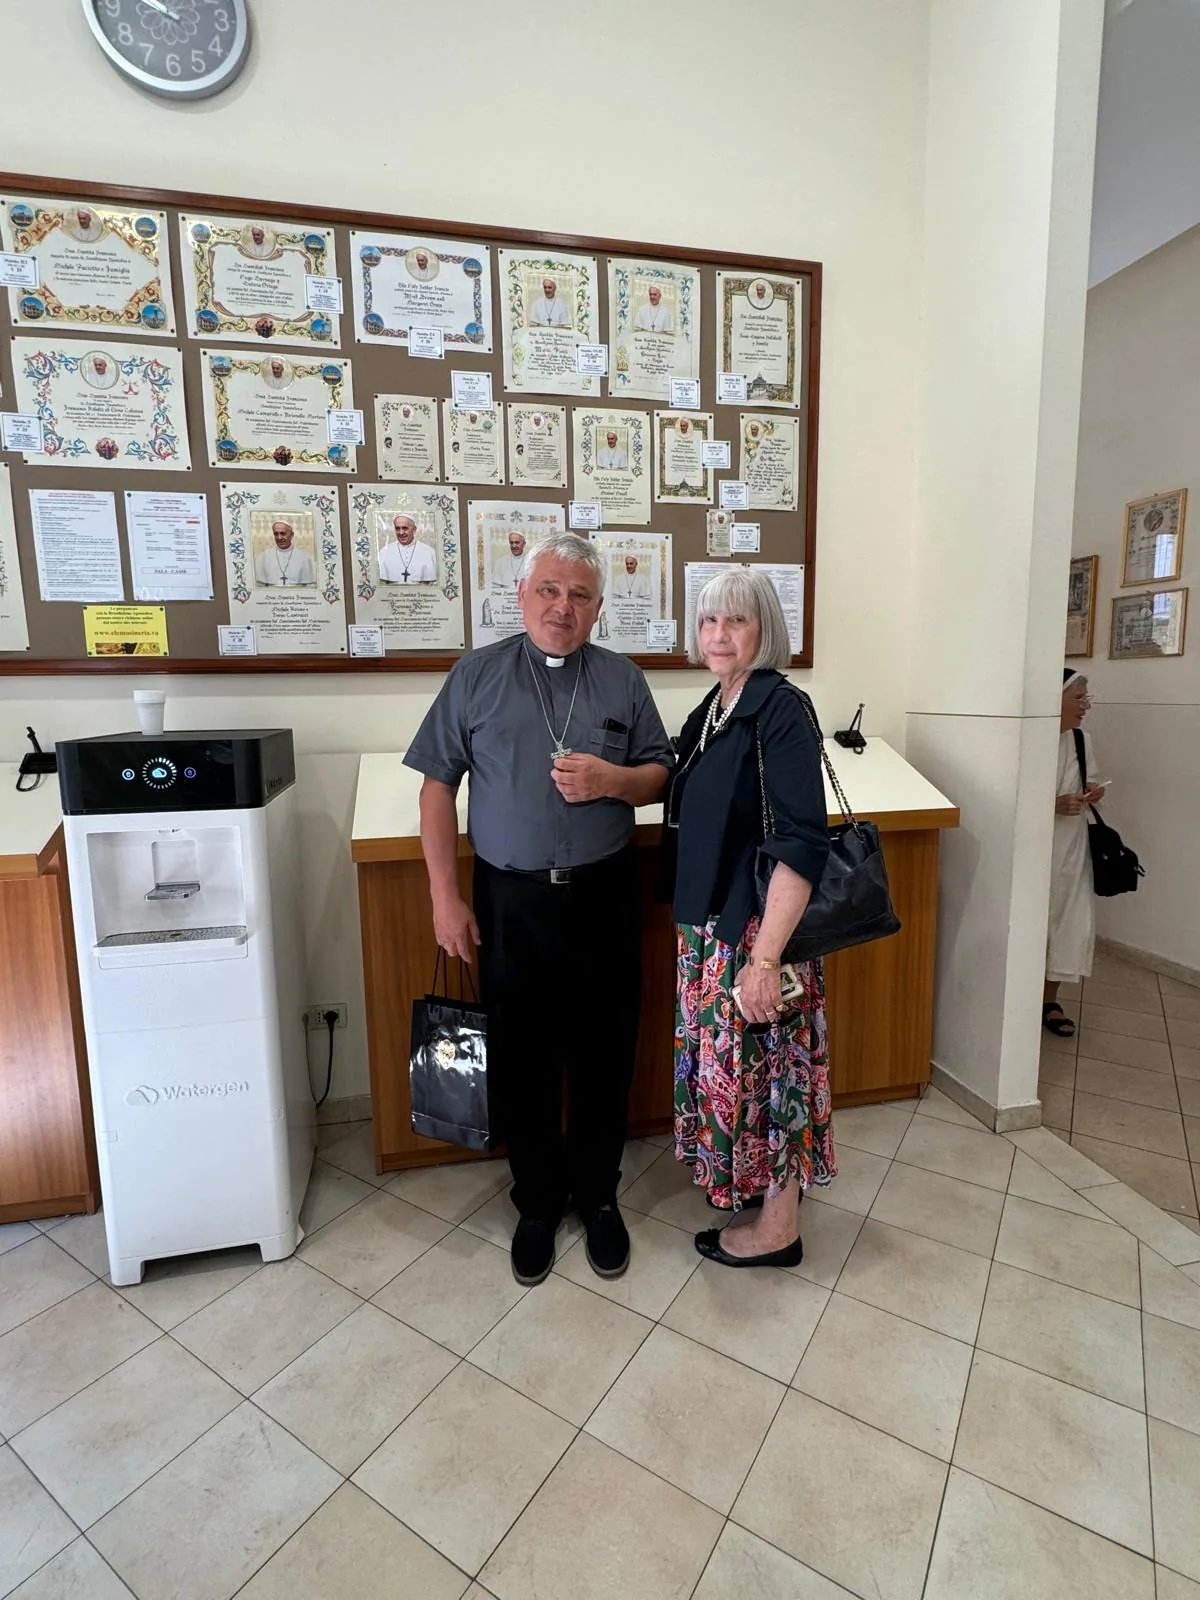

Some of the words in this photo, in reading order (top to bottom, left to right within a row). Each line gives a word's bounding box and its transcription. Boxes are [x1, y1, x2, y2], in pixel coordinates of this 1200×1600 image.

[105, 0, 121, 17] 9
[214, 9, 230, 31] 3
[117, 22, 134, 46] 8
[139, 43, 154, 66] 7
[207, 35, 223, 57] 4
[165, 53, 181, 77] 6
[191, 50, 206, 73] 5
[162, 1080, 250, 1099] Watergen
